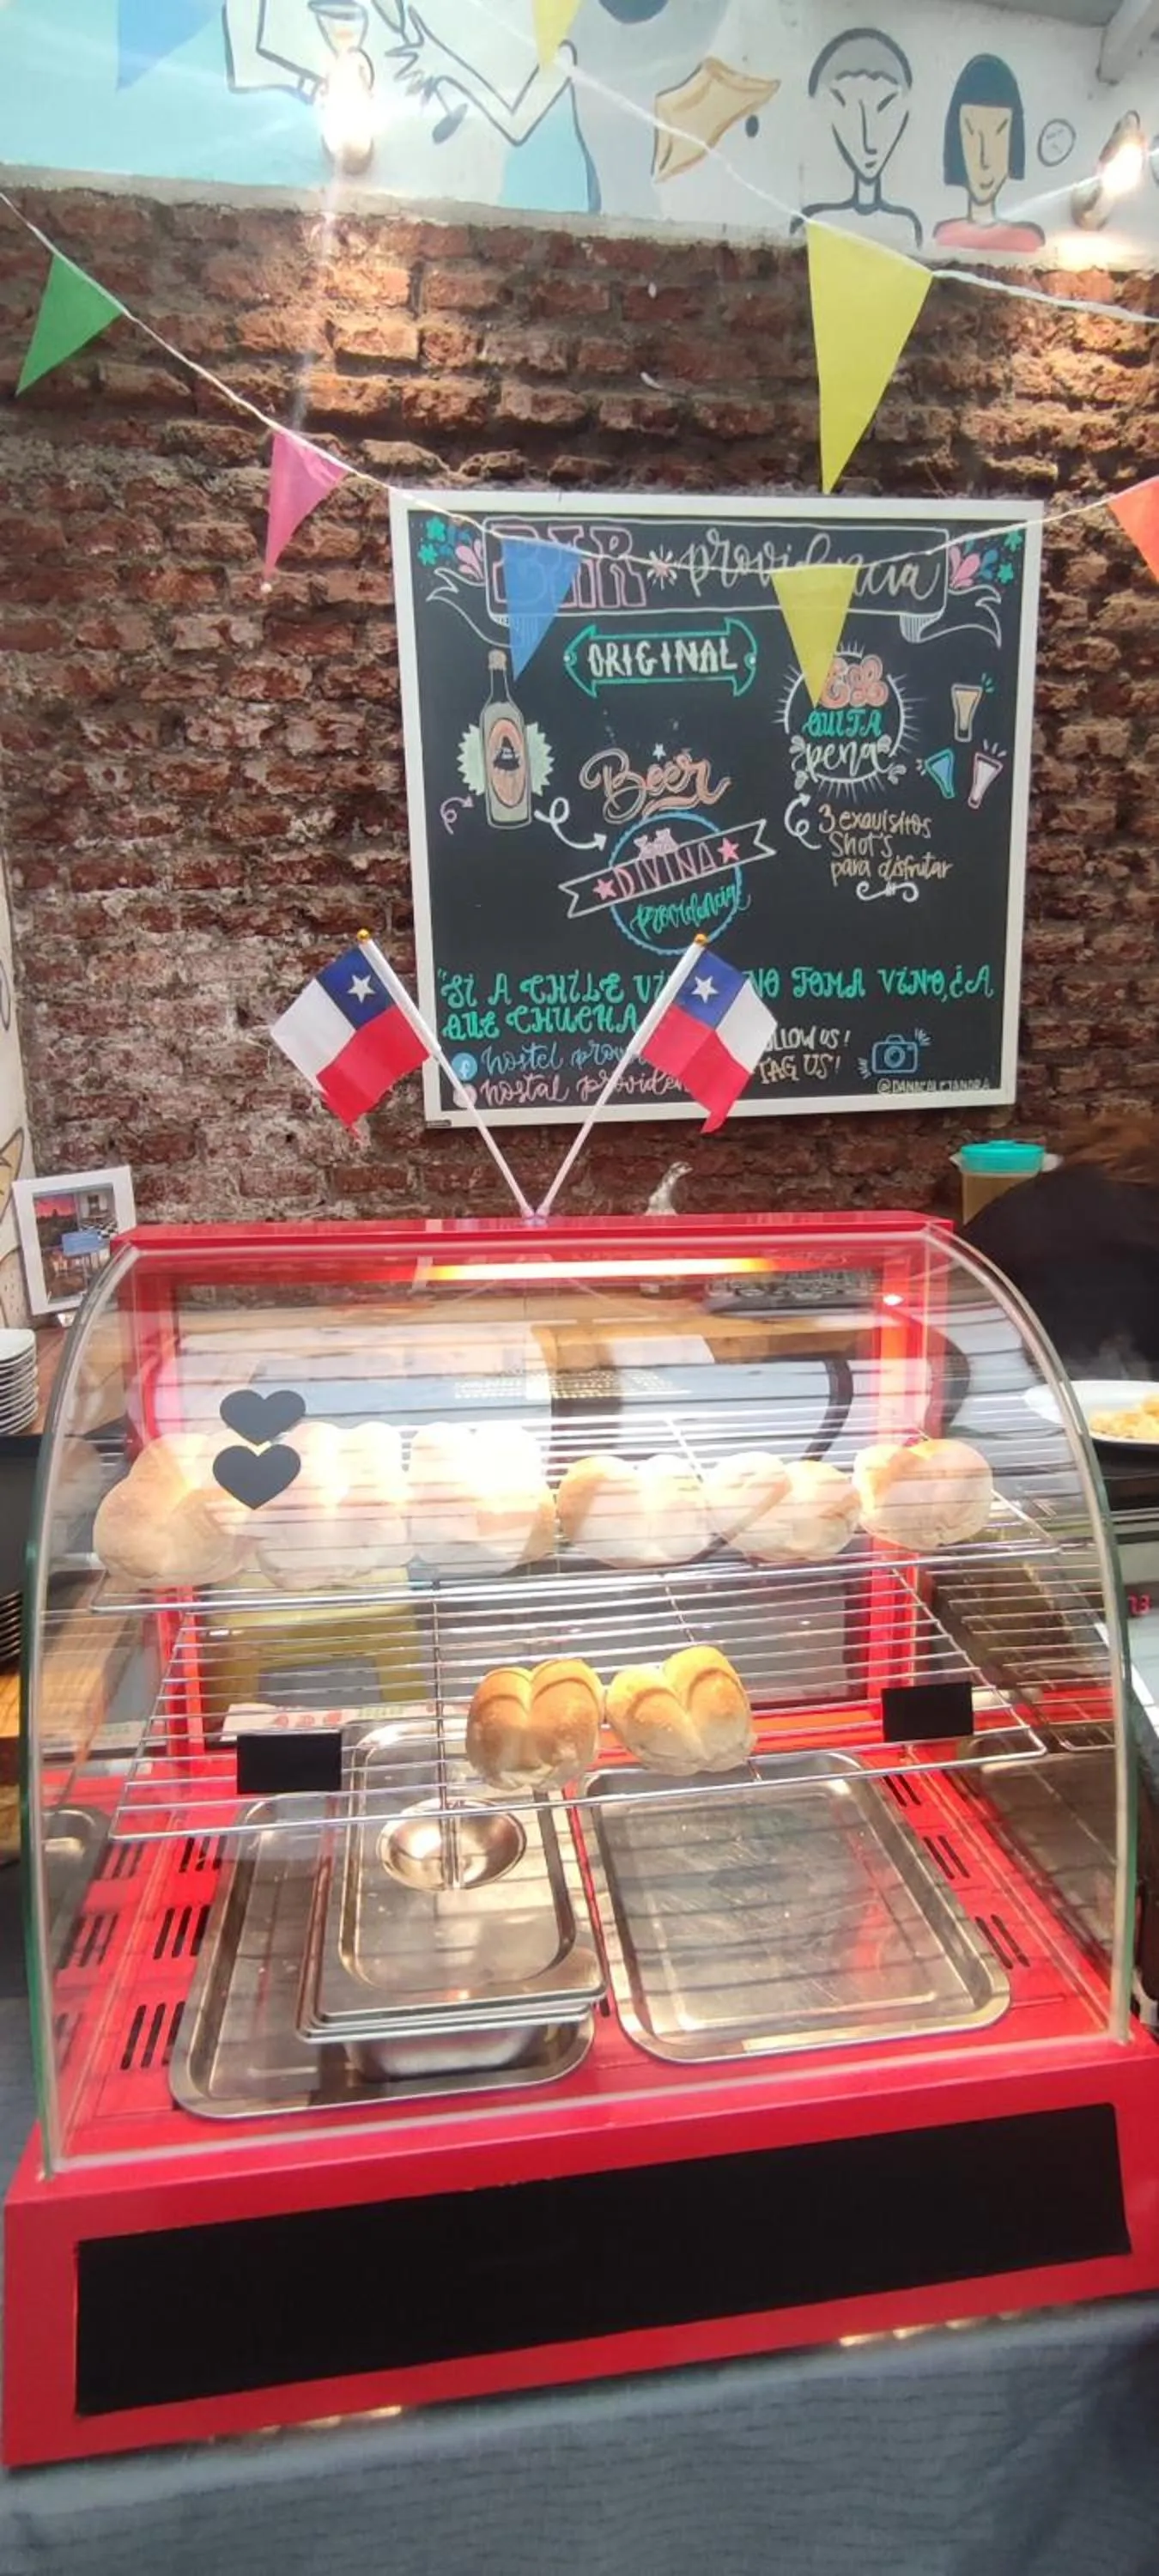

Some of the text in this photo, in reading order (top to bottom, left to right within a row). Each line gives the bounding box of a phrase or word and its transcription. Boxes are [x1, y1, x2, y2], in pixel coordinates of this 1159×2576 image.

[588, 637, 738, 677] ORIGINAL
[802, 708, 883, 738] QUITA
[577, 746, 732, 825] Beer
[818, 803, 836, 834] 3
[613, 840, 718, 898] DIVINA
[830, 852, 954, 887] para disfrutar
[487, 972, 513, 1005] A
[790, 966, 866, 999] TOMA
[441, 1004, 642, 1041] QUE CHUCHA
[481, 1040, 565, 1075] hostel
[758, 1054, 800, 1084] TAG
[479, 1073, 571, 1107] hostal
